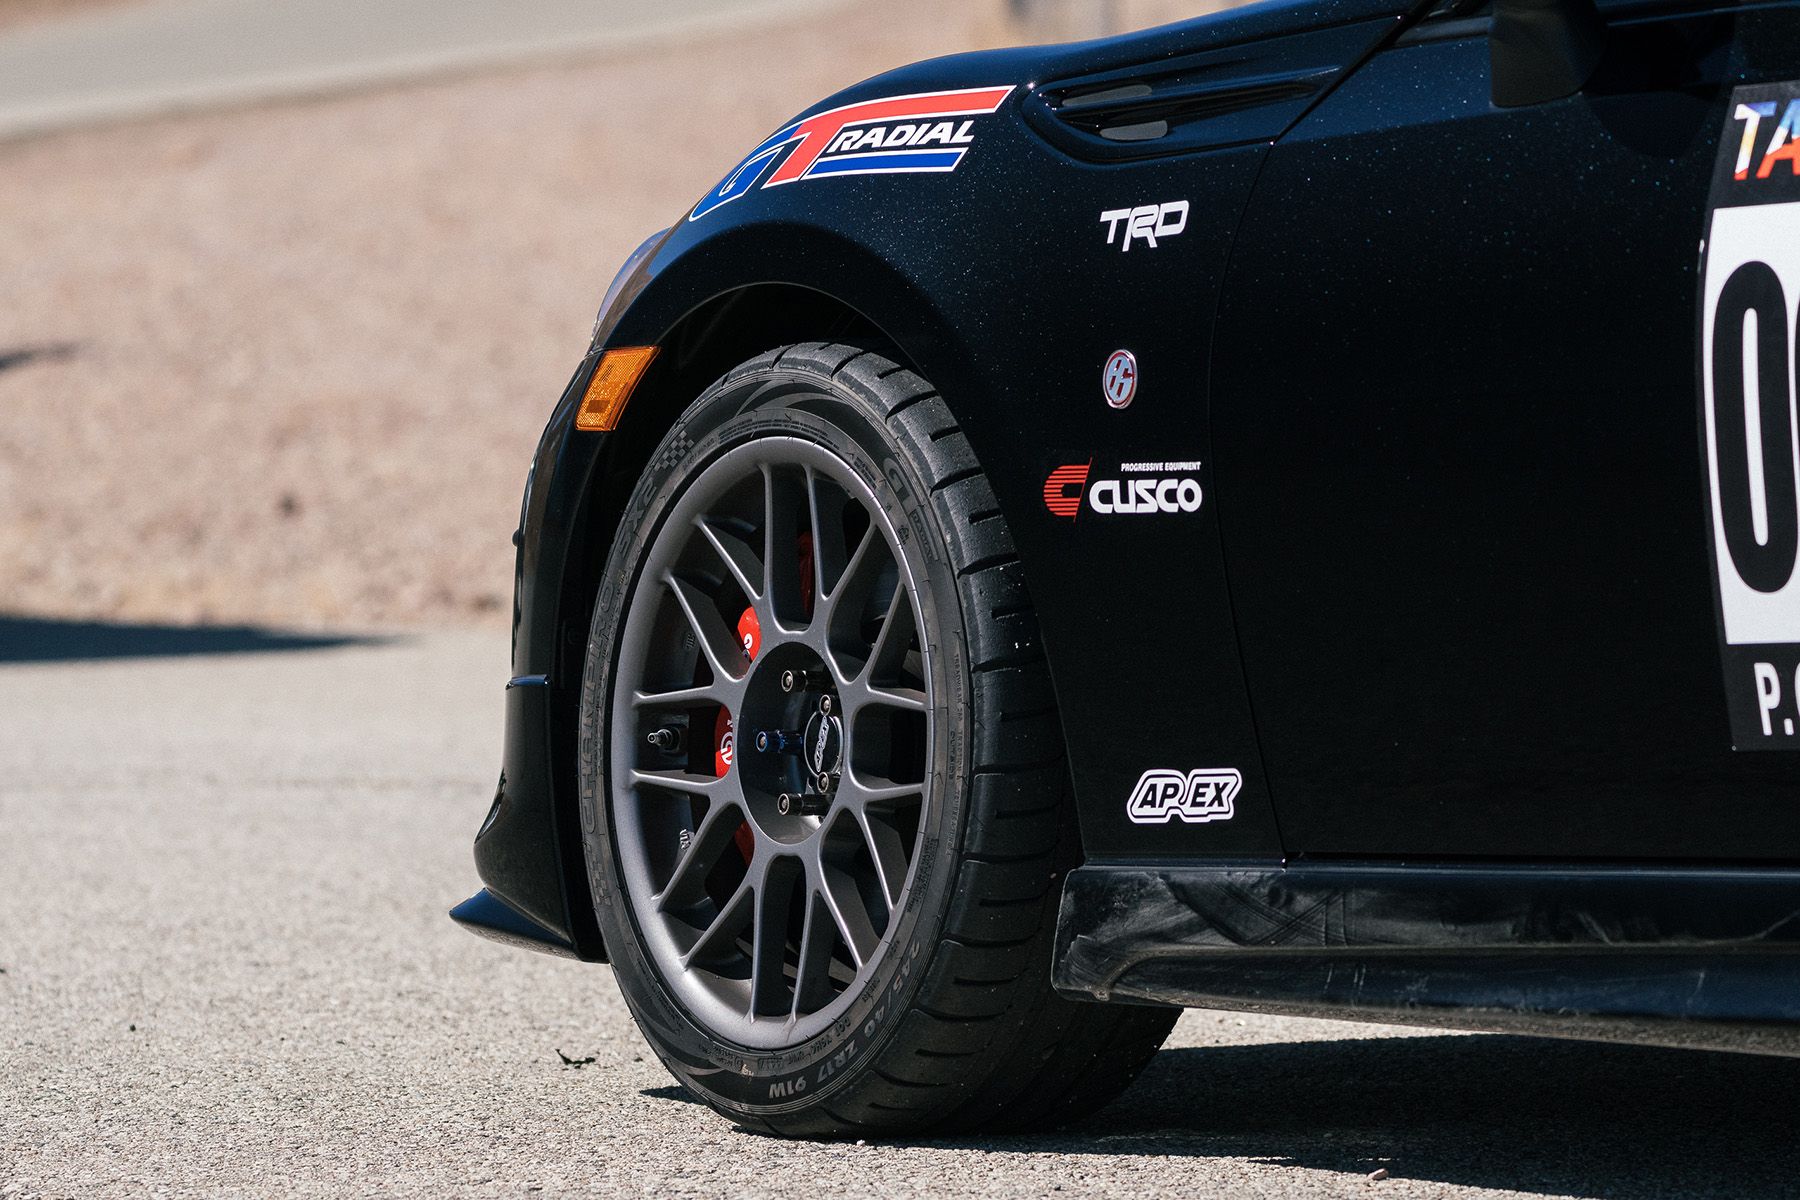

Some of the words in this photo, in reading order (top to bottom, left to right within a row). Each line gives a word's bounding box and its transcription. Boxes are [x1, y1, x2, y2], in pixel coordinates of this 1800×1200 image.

[827, 120, 975, 153] RADIAL
[1100, 200, 1189, 252] TRD
[1712, 260, 1800, 594] 0
[1121, 462, 1164, 472] PROGRESSIVE
[1165, 461, 1202, 471] EQUIPMENT
[1089, 478, 1202, 514] CUSCO
[1754, 661, 1800, 736] P.
[1137, 781, 1230, 809] APEX
[864, 939, 920, 1038] 245/40
[816, 1039, 858, 1083] ZR17
[768, 1076, 807, 1099] 91W
